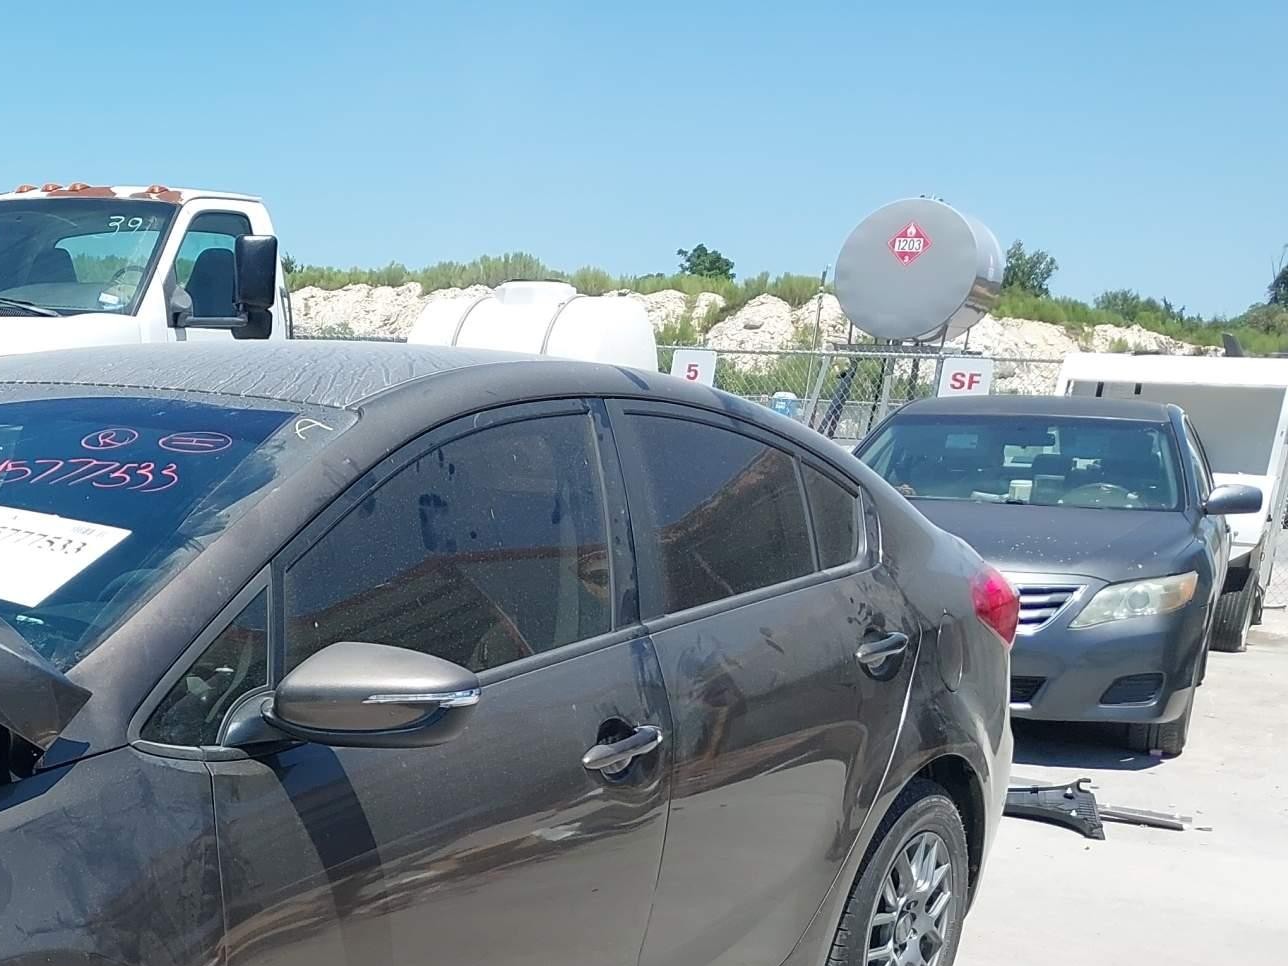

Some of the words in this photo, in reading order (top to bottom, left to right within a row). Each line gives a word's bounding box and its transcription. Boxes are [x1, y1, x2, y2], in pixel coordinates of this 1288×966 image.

[897, 239, 922, 251] 1203
[686, 363, 699, 381] 5
[949, 372, 982, 390] SF
